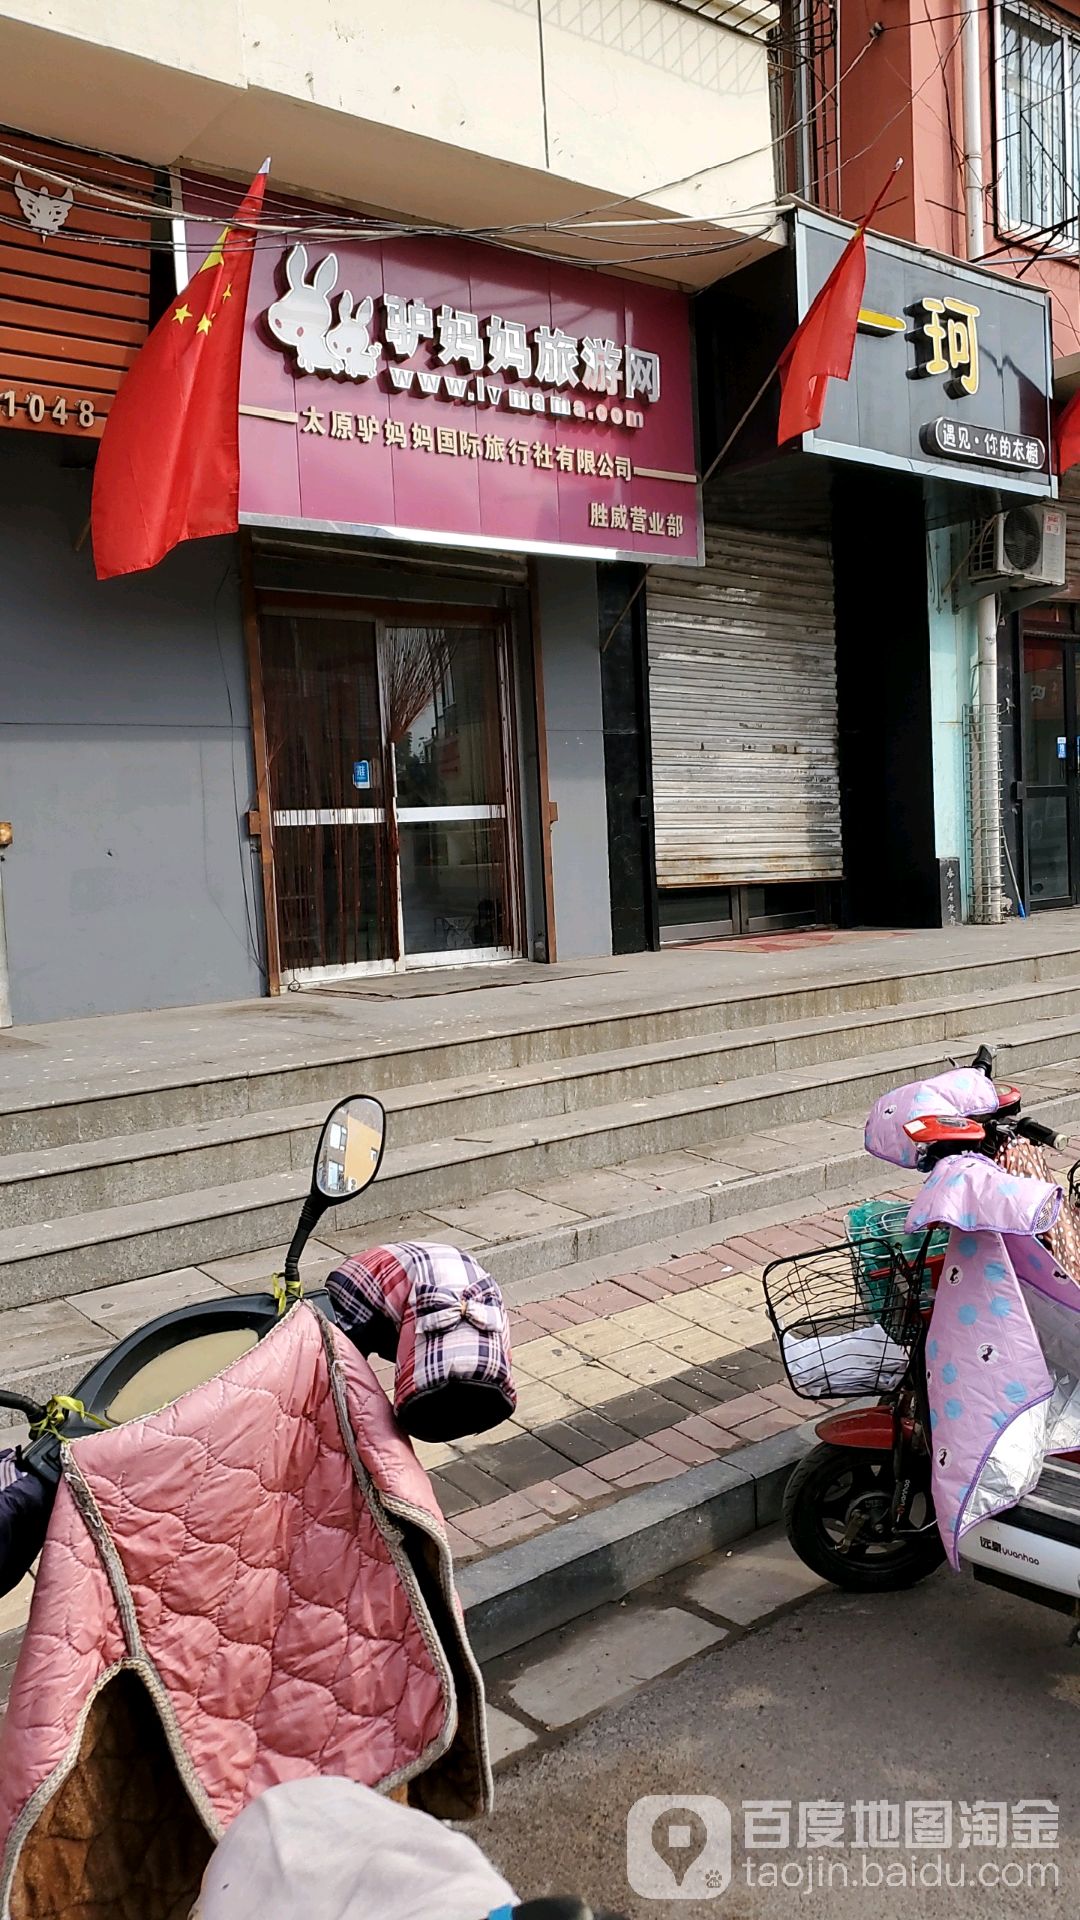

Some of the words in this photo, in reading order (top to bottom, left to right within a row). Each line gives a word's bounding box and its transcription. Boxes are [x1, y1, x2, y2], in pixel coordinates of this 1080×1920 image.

[383, 293, 660, 403] 驴妈妈旅游网
[3, 390, 95, 427] 1048
[389, 367, 644, 428] www.lvmama.com
[302, 406, 632, 481] 太原驴妈妈国际旅行社有限公司
[590, 502, 684, 537] 胜威营业部
